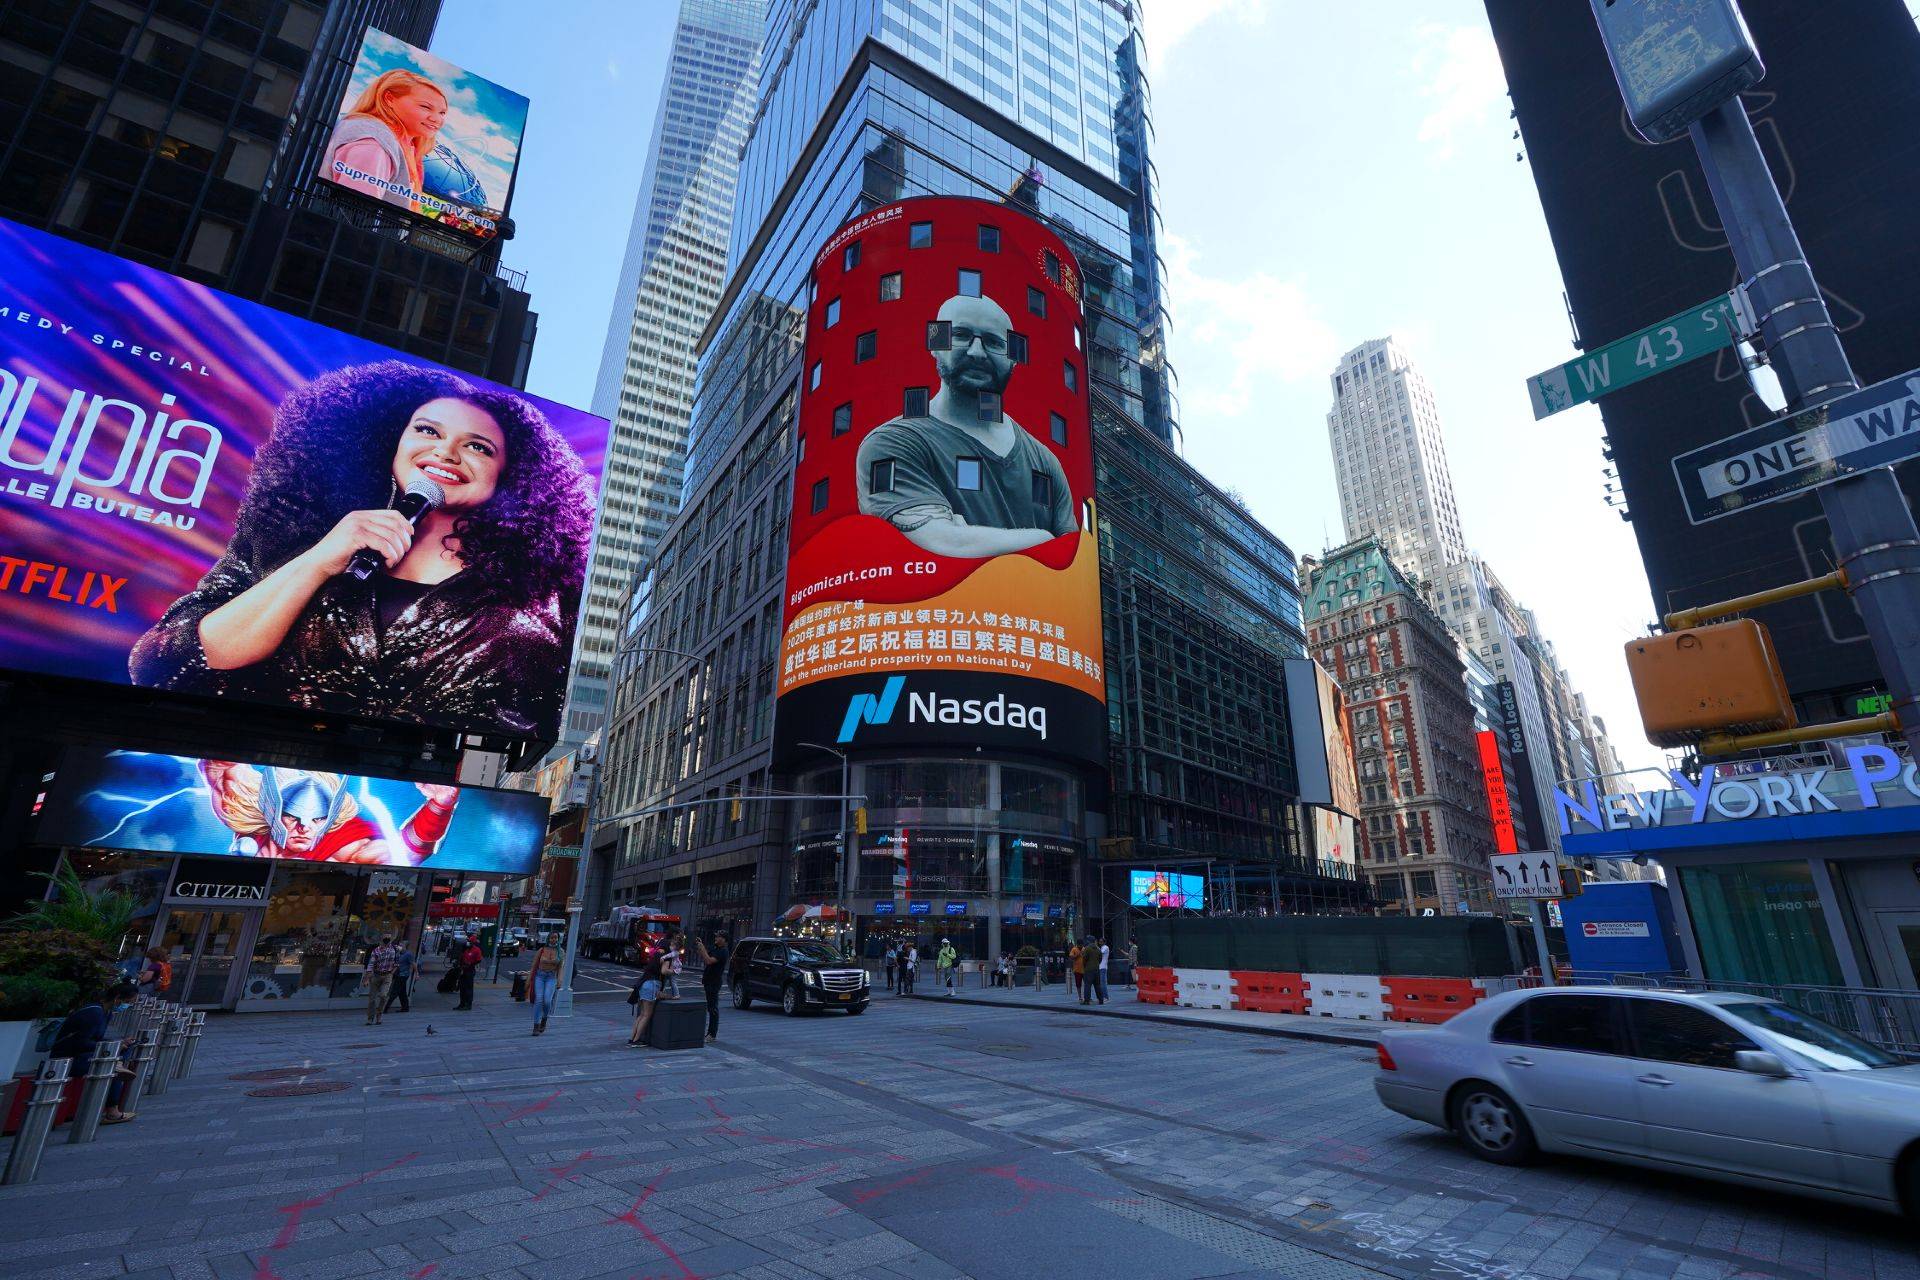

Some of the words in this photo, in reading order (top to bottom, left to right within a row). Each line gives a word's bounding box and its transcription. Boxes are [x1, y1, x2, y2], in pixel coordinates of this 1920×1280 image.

[334, 161, 496, 230] SupremeMasterTV.com
[92, 334, 210, 376] SPECIAL
[1575, 352, 1611, 395] W
[1634, 325, 1684, 370] 43
[1701, 302, 1730, 333] St
[1723, 435, 1817, 487] ONE
[1854, 399, 1920, 443] WA
[0, 478, 50, 500] LE
[71, 492, 196, 531] BUTEAU
[0, 555, 129, 614] TFLIX
[790, 566, 893, 606] Bigcomicart.com
[903, 561, 937, 575] CEO
[797, 670, 809, 681] the
[811, 656, 867, 676] motherland
[870, 653, 932, 668] prosperity
[936, 654, 952, 663] on
[956, 654, 1008, 667] National
[1011, 659, 1032, 672] Day
[909, 692, 1048, 741] Nasdaq
[548, 846, 581, 858] BROADWAY
[887, 836, 908, 844] Nasdaq
[176, 881, 265, 900] CITIZEN
[1496, 888, 1515, 897] ONLY
[1517, 886, 1536, 895] ONLY
[1539, 885, 1559, 894] ONLY
